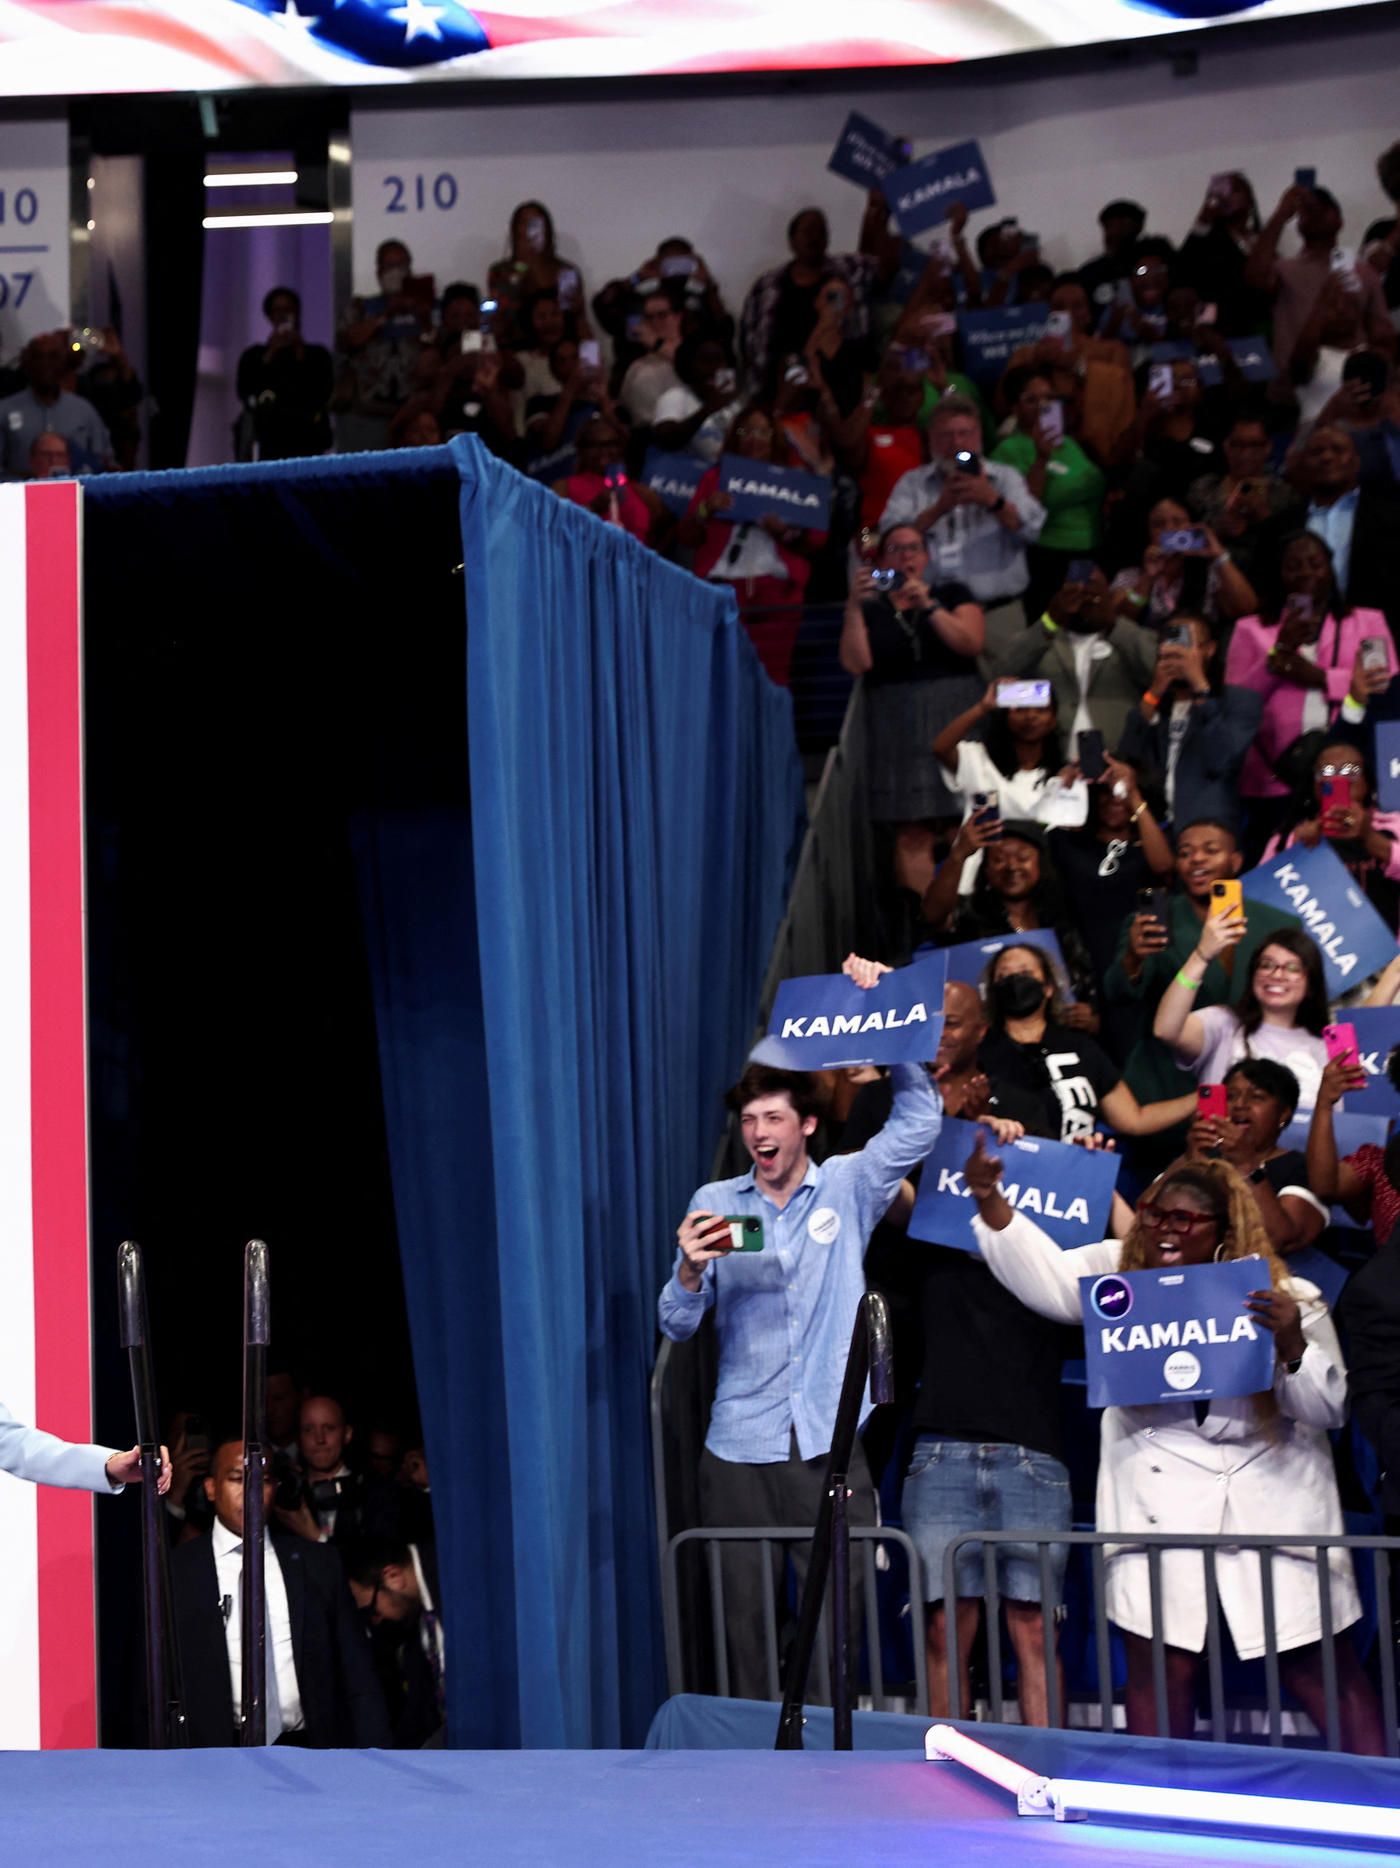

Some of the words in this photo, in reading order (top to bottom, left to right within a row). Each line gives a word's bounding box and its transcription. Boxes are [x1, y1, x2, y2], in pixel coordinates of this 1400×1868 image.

[383, 172, 458, 213] 210
[897, 166, 981, 211] KAMALA
[650, 474, 698, 498] KAM
[728, 477, 820, 508] KAMALA
[1273, 862, 1359, 977] KAMALA
[781, 1003, 928, 1039] KAMALA
[1101, 1315, 1259, 1354] KAMALA
